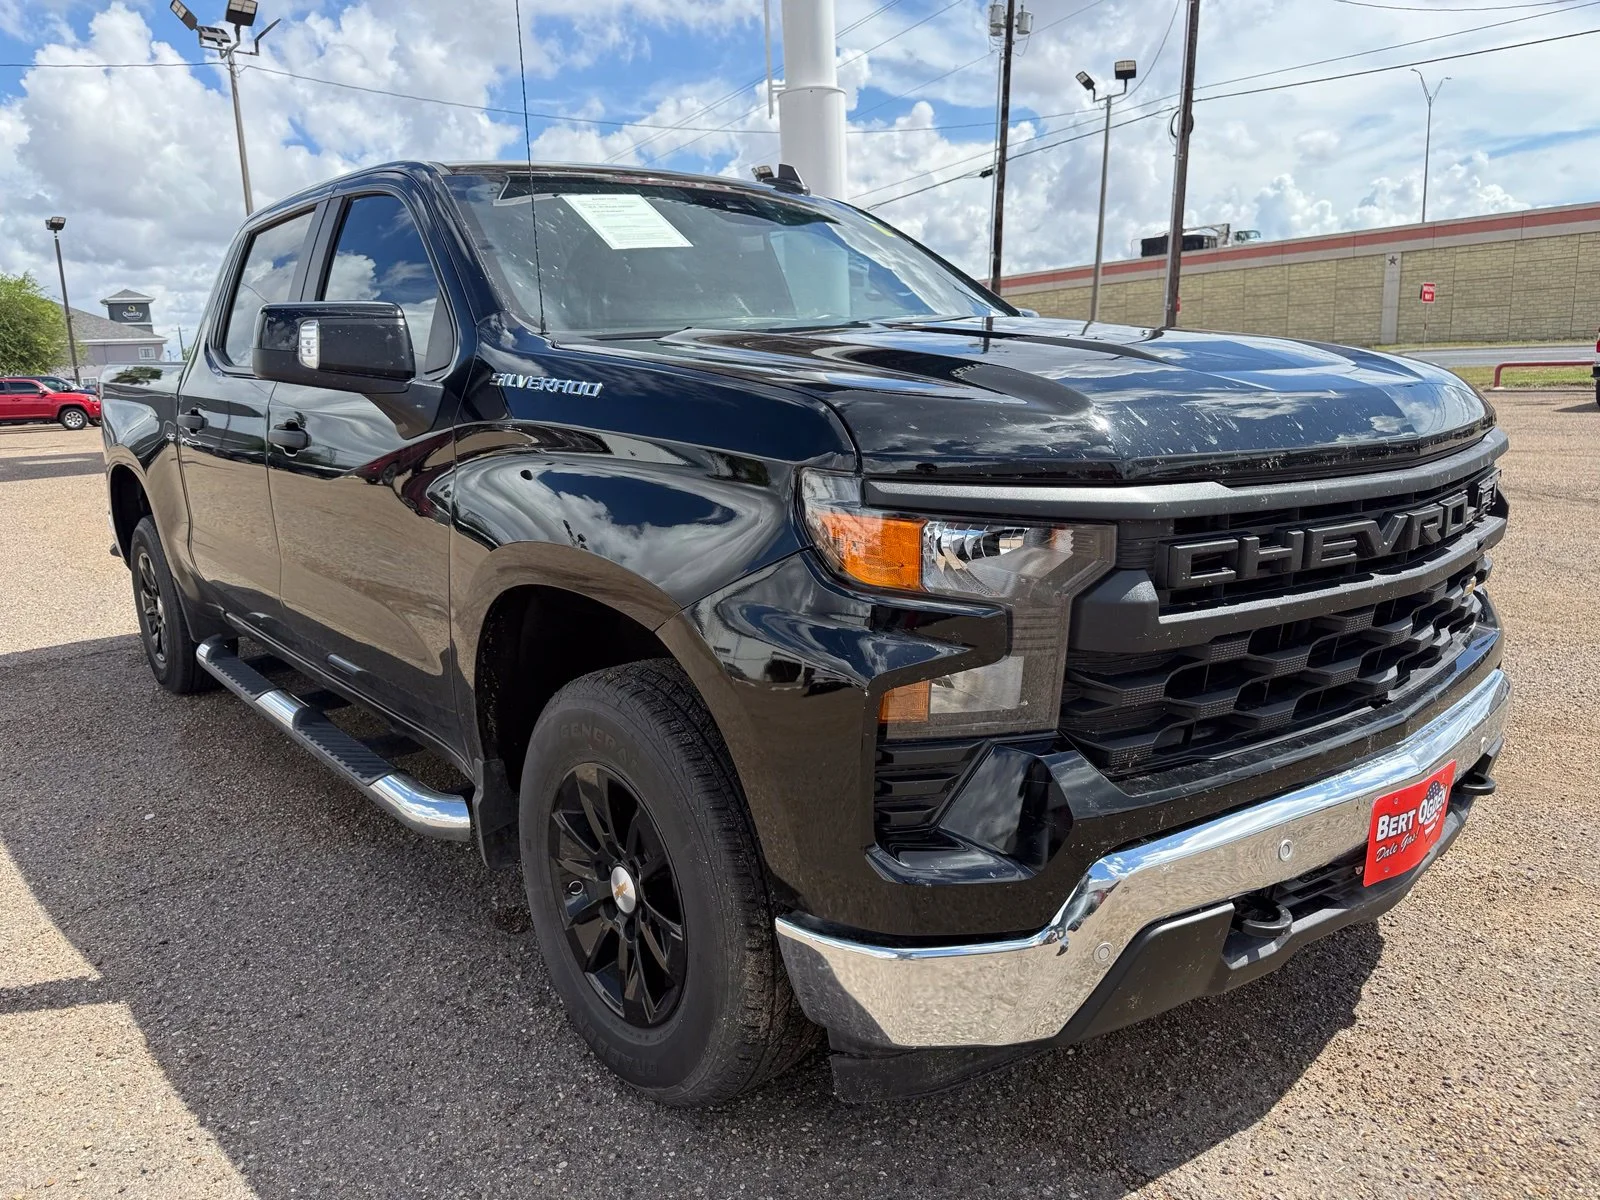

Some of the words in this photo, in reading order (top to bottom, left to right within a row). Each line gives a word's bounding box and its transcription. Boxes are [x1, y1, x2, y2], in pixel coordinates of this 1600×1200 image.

[489, 372, 603, 397] SILVERADO
[1376, 808, 1417, 842] BERT
[1418, 785, 1448, 825] OGDEN
[1375, 844, 1398, 863] Dale
[1400, 825, 1421, 852] Gas!
